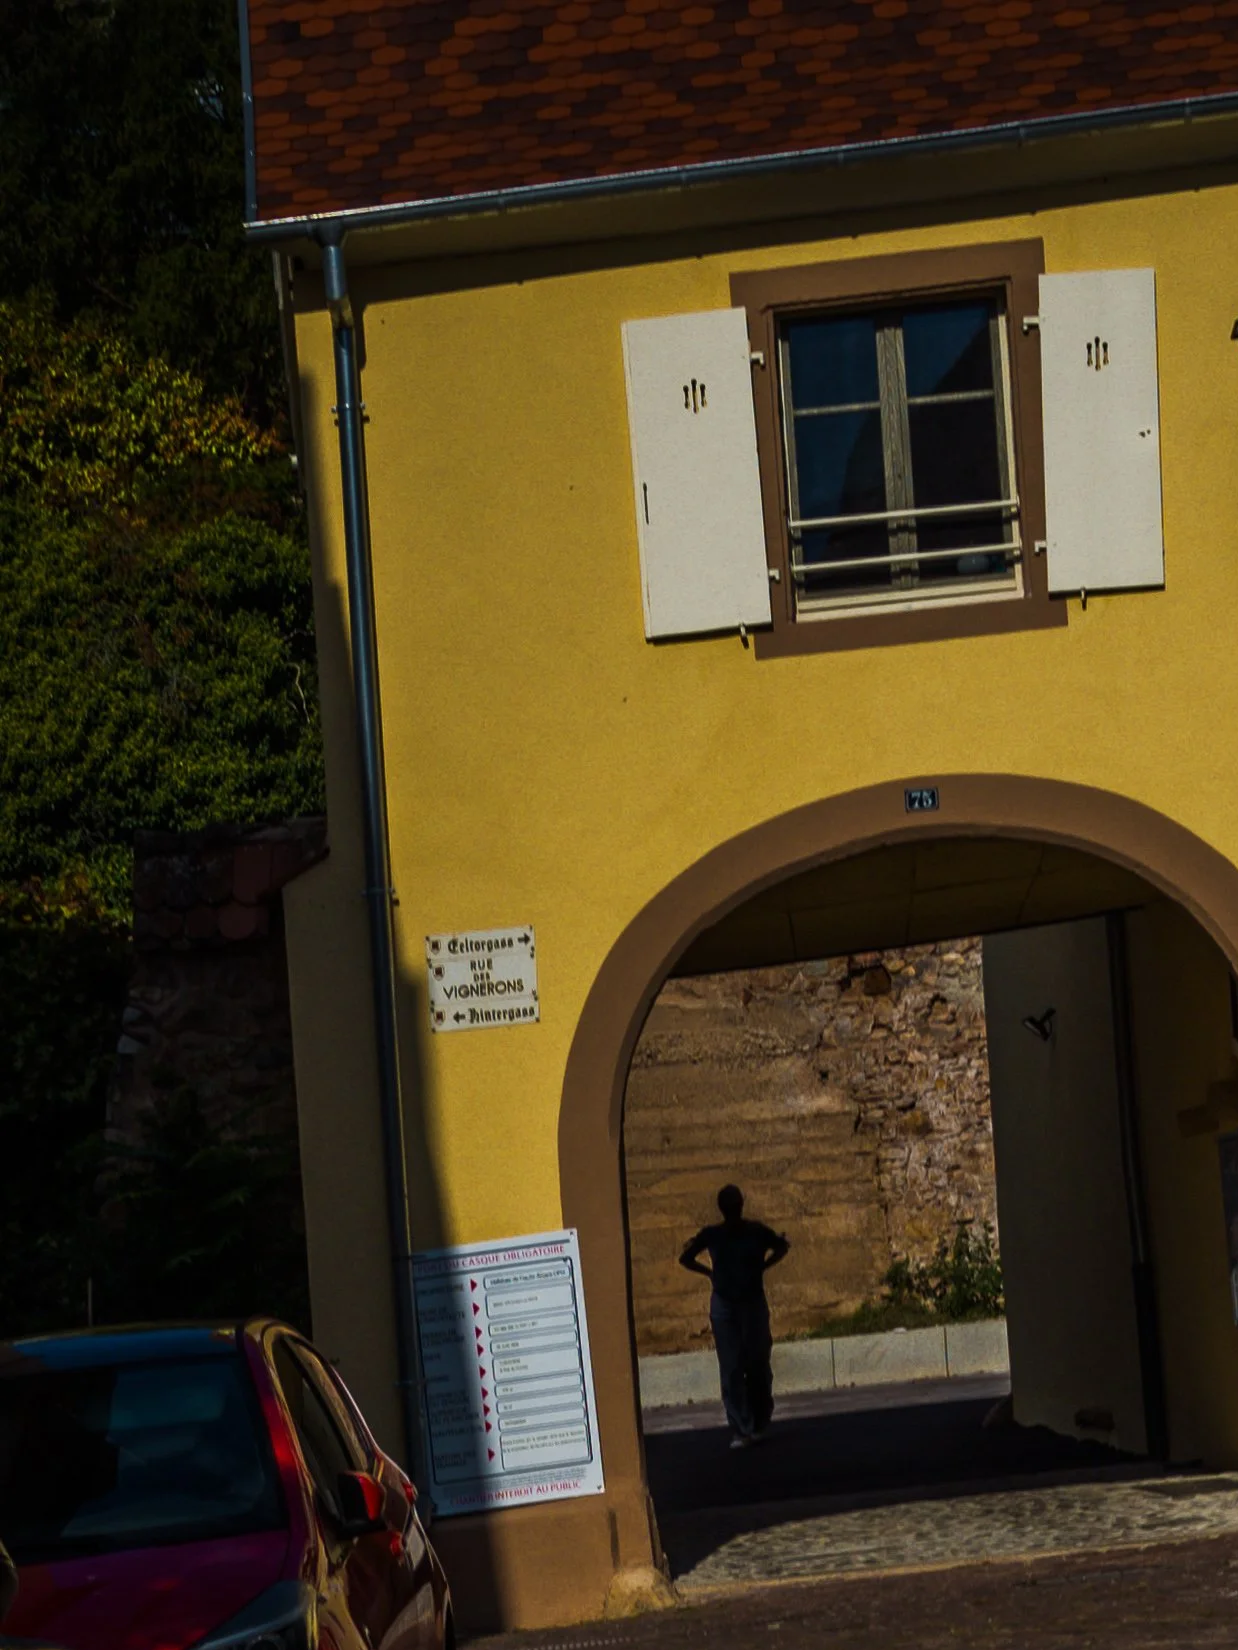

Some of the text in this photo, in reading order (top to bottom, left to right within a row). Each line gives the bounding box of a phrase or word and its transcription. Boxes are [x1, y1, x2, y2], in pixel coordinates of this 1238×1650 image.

[470, 958, 493, 972] RUE
[473, 972, 491, 983] DES
[443, 978, 525, 1000] VIGNERONS
[462, 1253, 500, 1267] CASQUE
[503, 1245, 565, 1261] OBLIGATOIRE
[495, 1486, 534, 1501] INTERDIT
[536, 1484, 549, 1496] AU
[550, 1480, 581, 1492] PUBLIC
